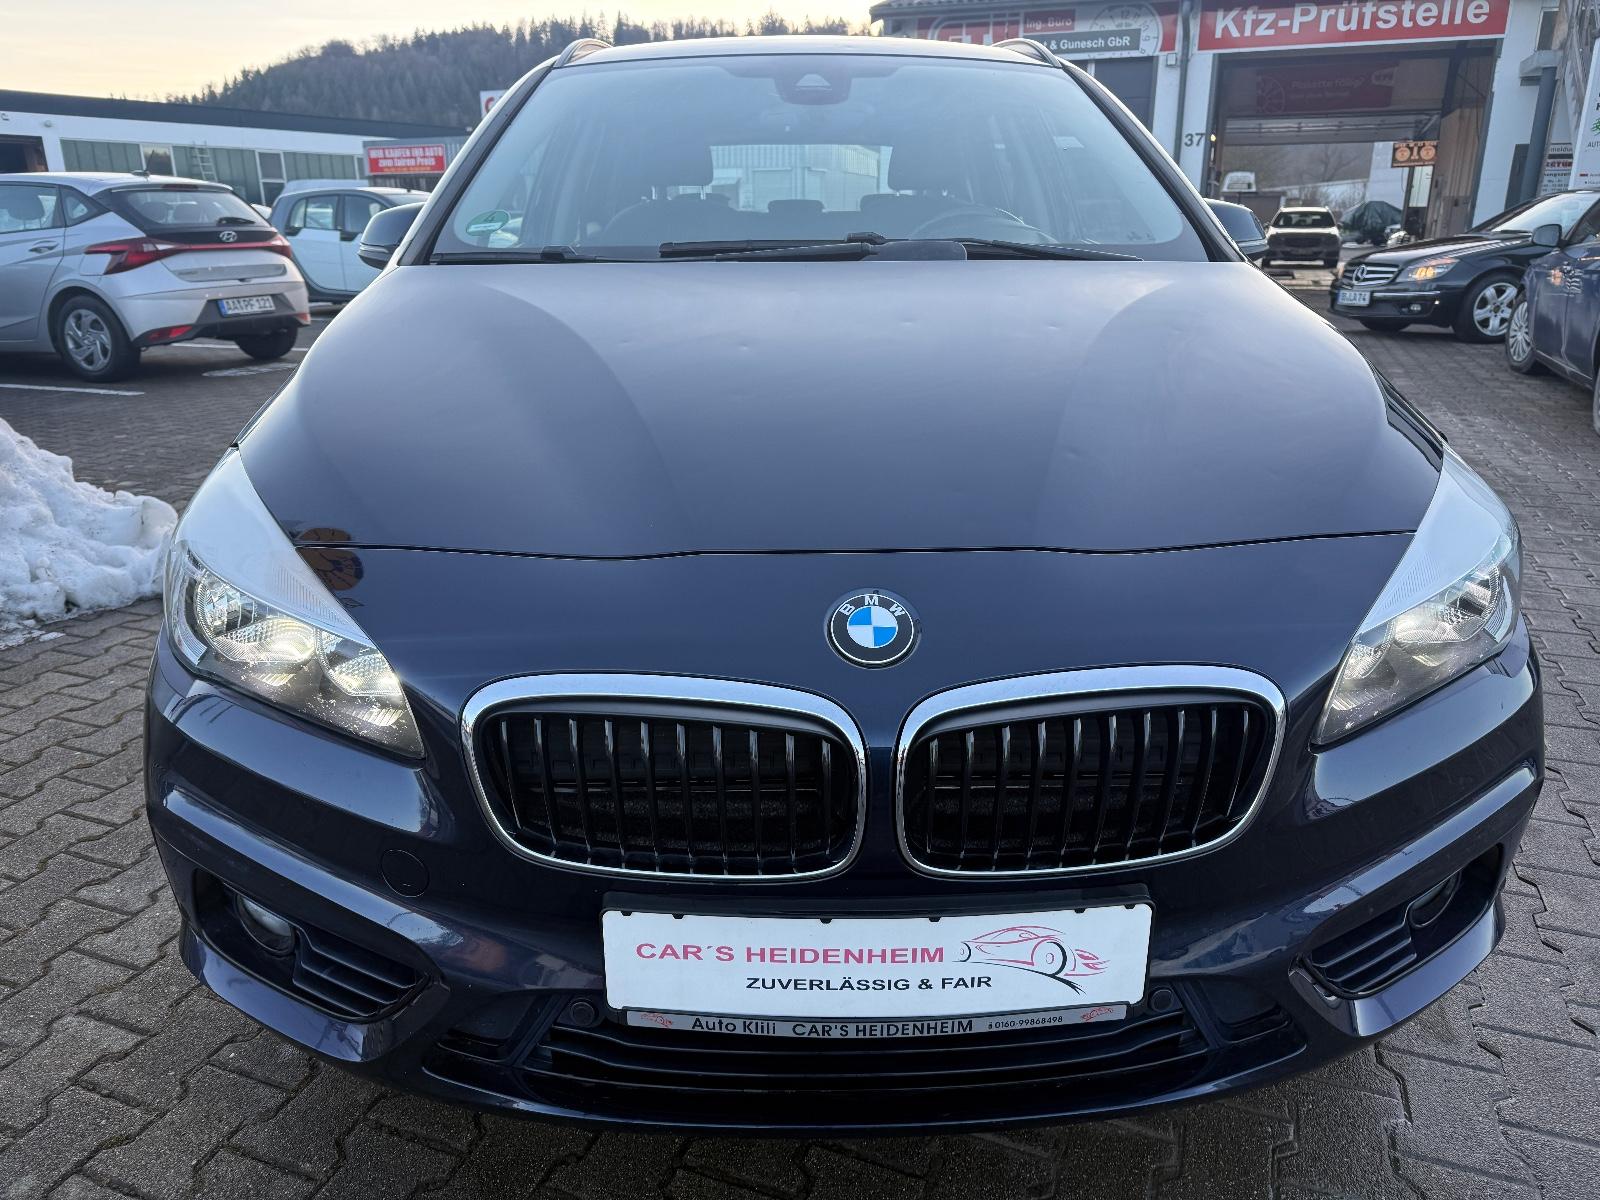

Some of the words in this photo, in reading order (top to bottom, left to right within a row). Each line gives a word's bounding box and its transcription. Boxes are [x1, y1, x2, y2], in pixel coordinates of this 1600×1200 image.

[1026, 19, 1045, 31] Ing.
[1047, 16, 1072, 27] Büro
[1213, 0, 1490, 39] Kfz-Prüfstelle
[1060, 38, 1105, 50] Gunesch
[1107, 36, 1130, 47] GbR
[1184, 133, 1206, 147] 37
[839, 595, 906, 616] BMW
[746, 947, 944, 964] HEIDENHEIM
[746, 976, 910, 991] ZUVERLÄSSIG
[917, 979, 933, 990] &
[941, 976, 992, 989] FAIR
[691, 1017, 737, 1032] Auto
[792, 1023, 849, 1037] CAR'S
[855, 1019, 973, 1037] HEIDENHEIM
